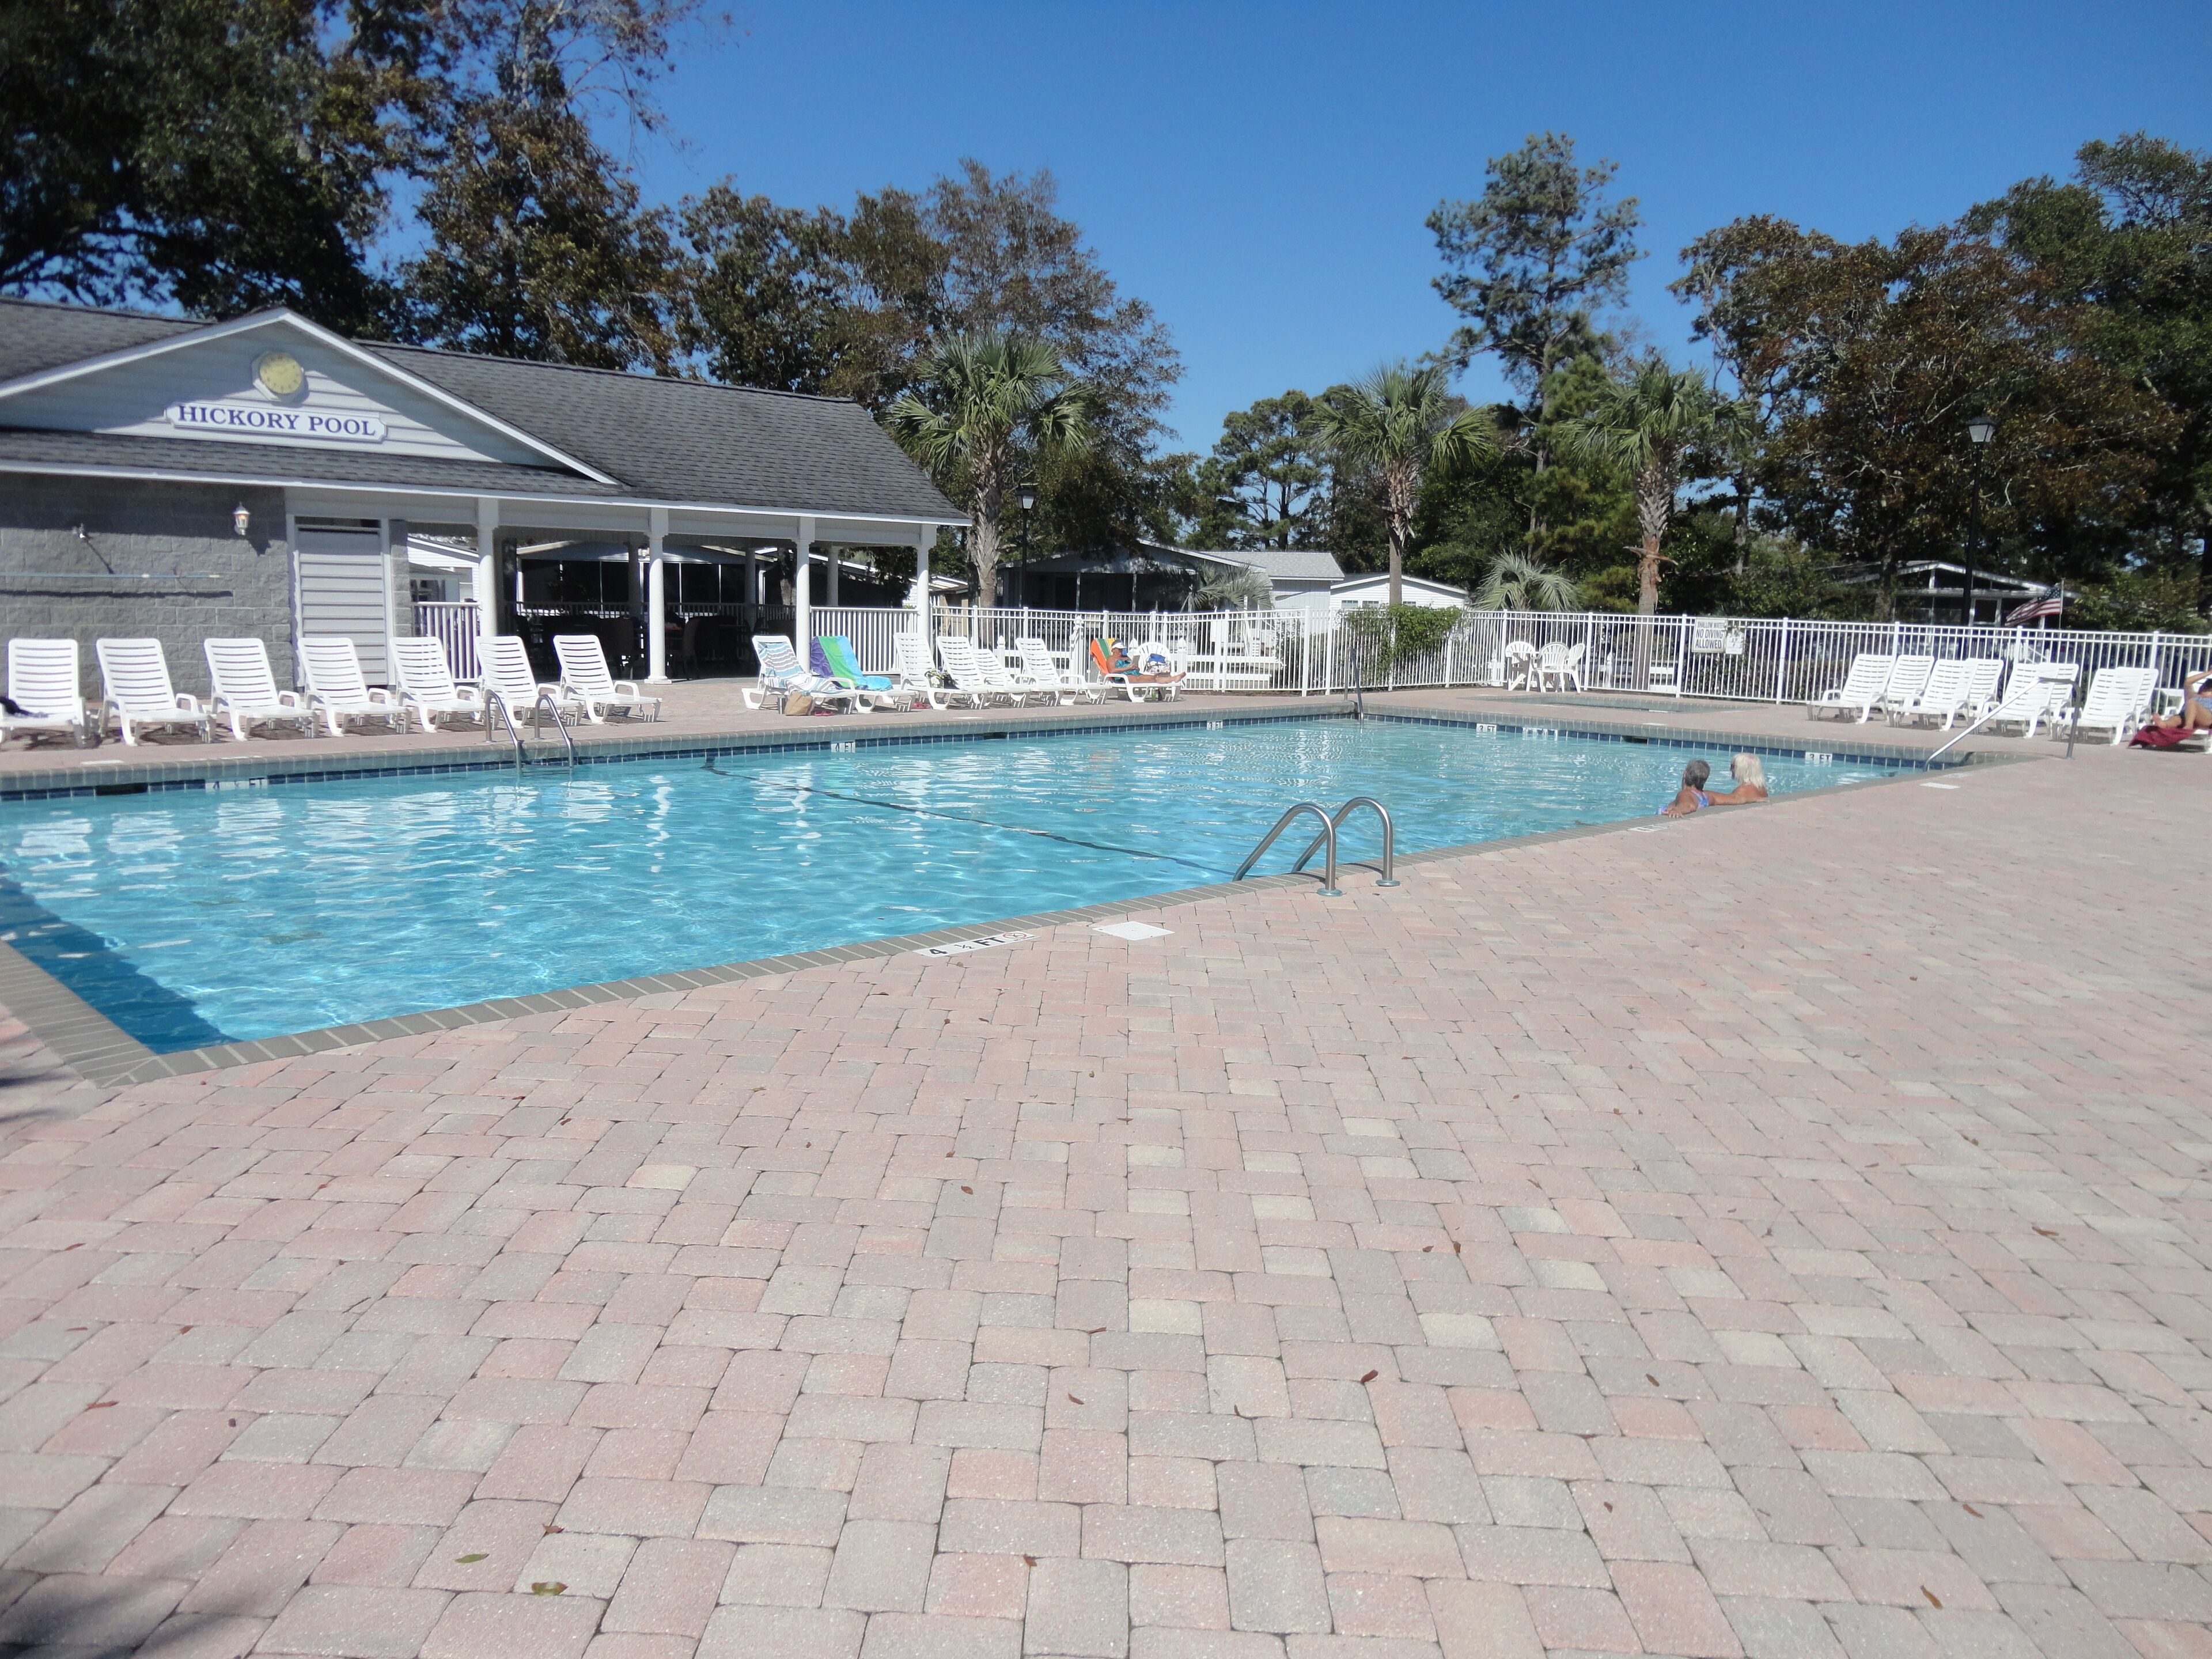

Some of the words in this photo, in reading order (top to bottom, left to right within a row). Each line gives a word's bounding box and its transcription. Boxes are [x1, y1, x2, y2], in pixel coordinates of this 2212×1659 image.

[178, 406, 300, 430] HICKORY
[309, 416, 376, 437] POOL
[1696, 629, 1704, 638] NO
[1705, 629, 1723, 639] DIVING
[1695, 639, 1722, 649] ALLOWED
[972, 937, 1006, 946] FT
